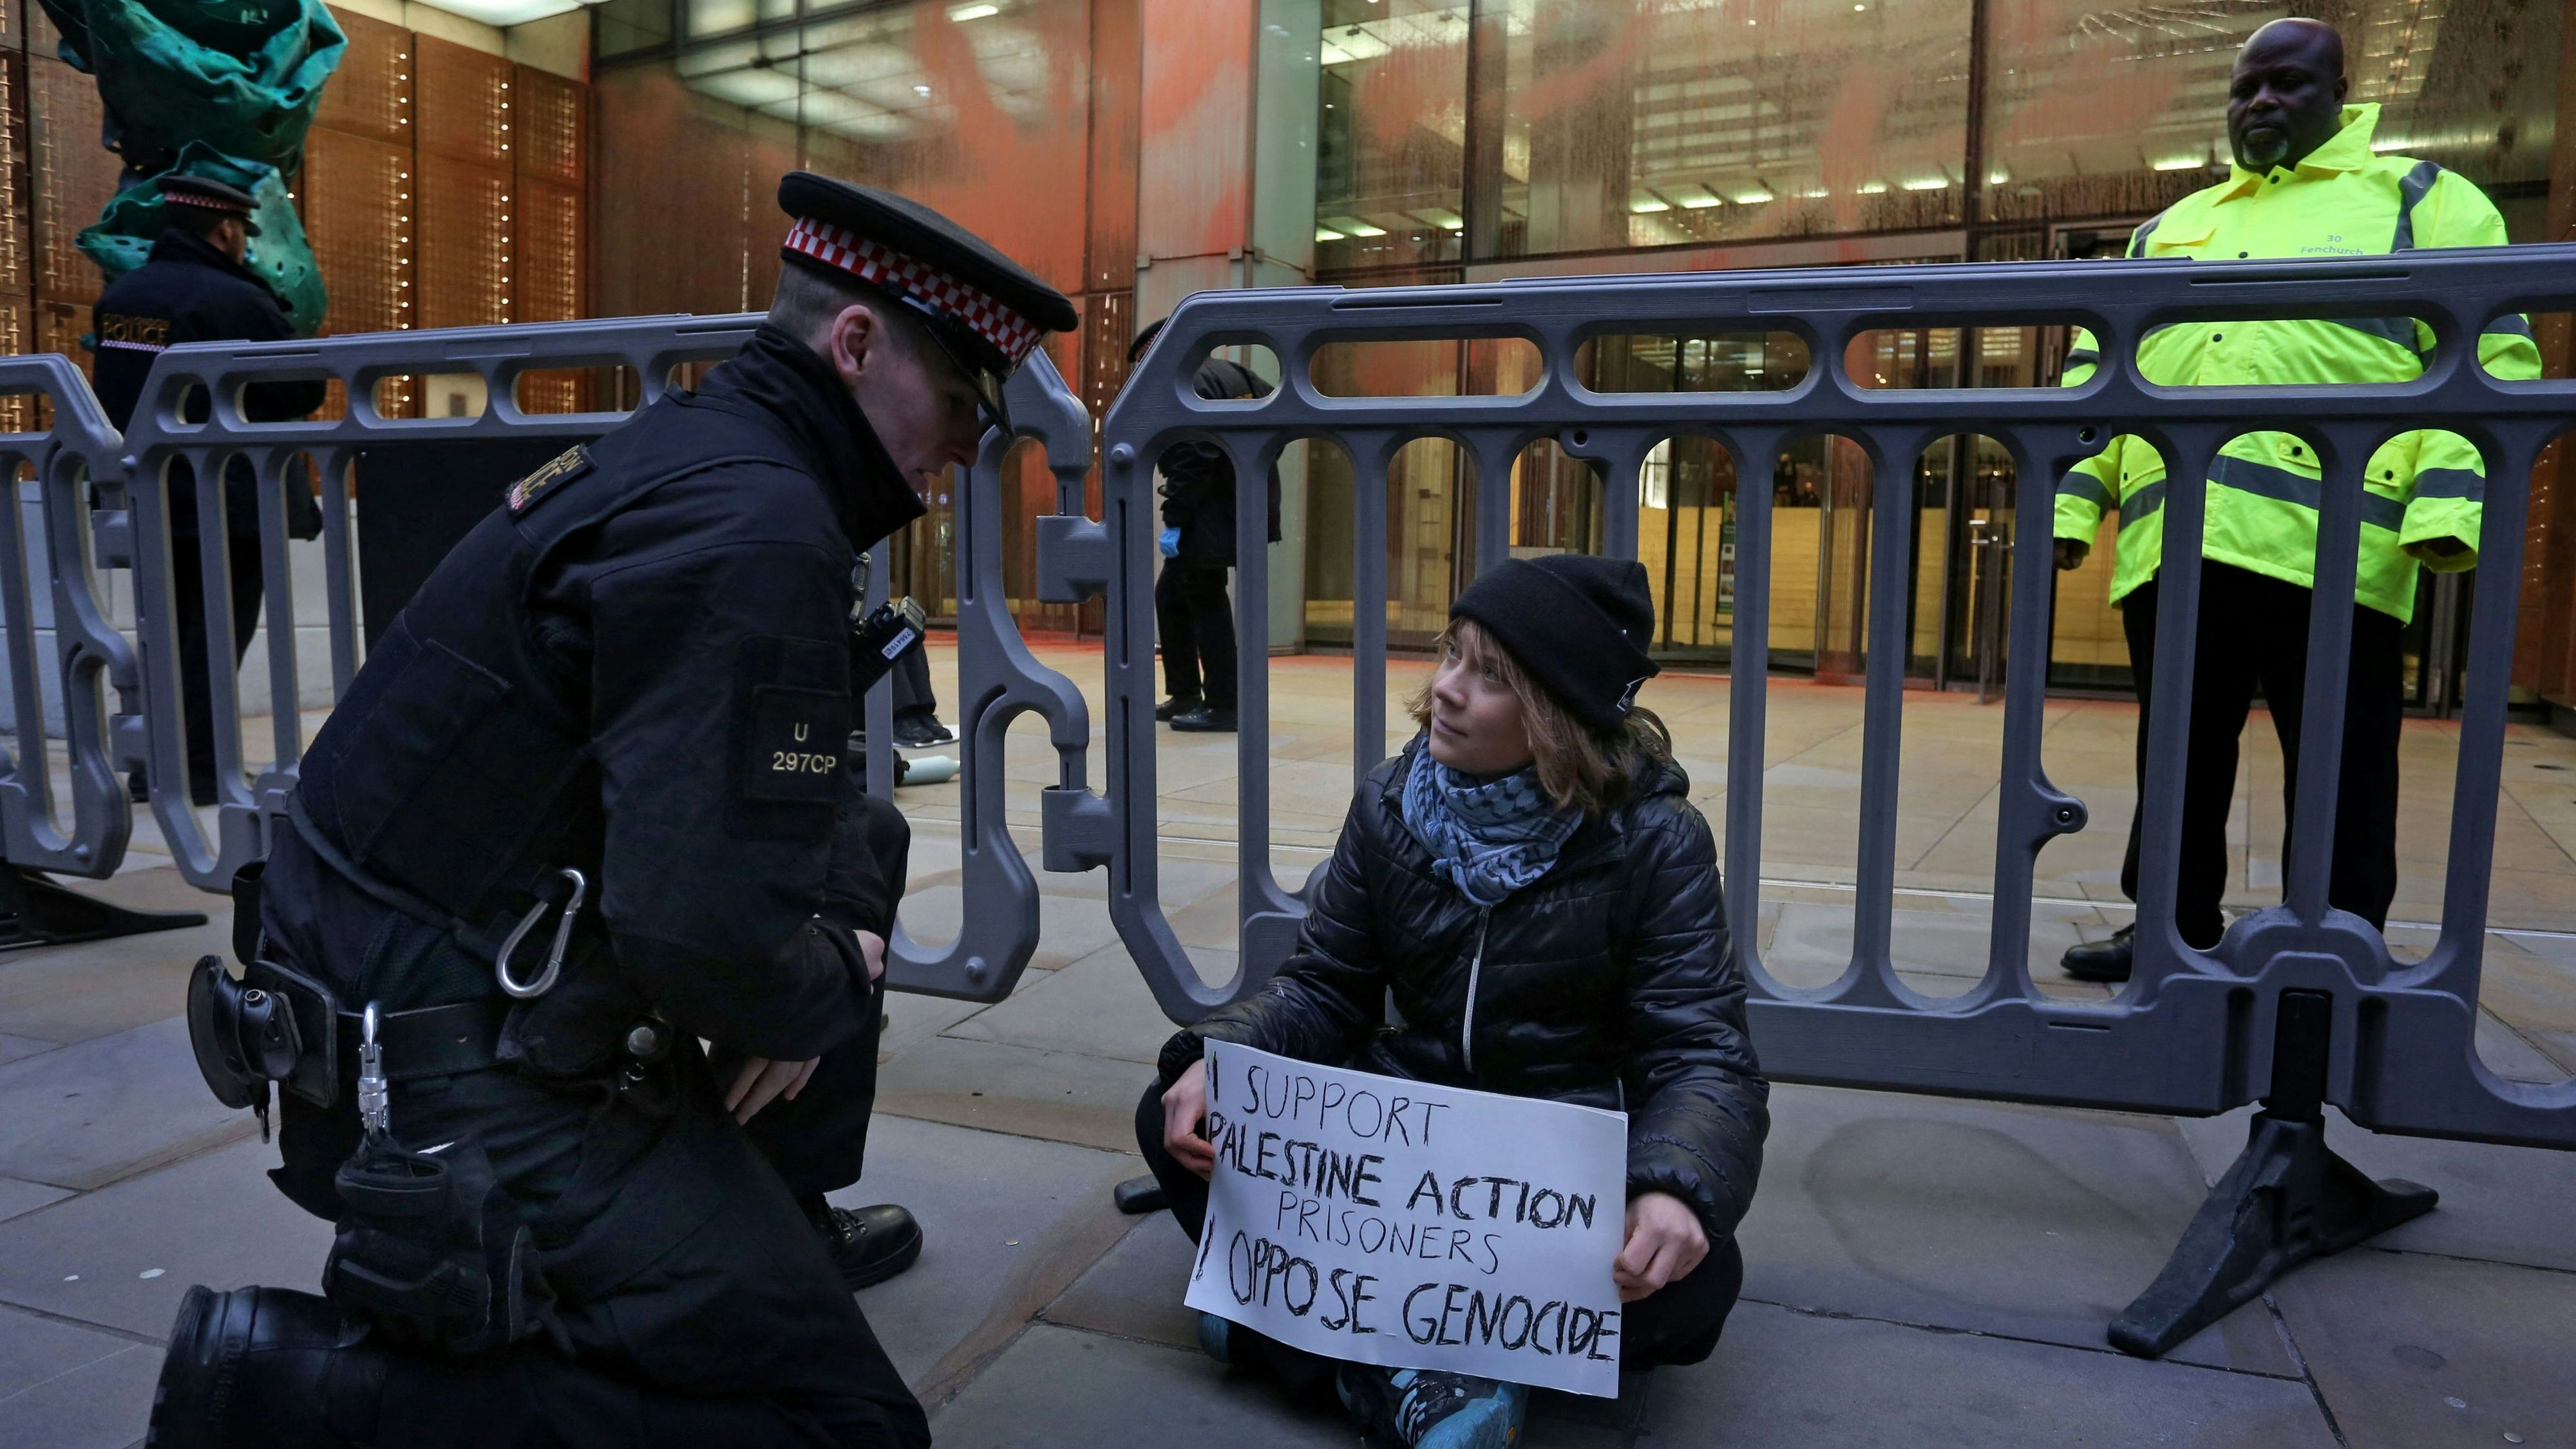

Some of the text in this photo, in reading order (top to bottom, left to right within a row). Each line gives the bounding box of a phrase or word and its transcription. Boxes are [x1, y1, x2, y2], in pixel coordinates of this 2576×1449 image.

[2300, 246, 2363, 255] Fenchurch
[102, 321, 169, 345] POLICE
[794, 722, 809, 742] U
[772, 750, 837, 775] 297CP
[1242, 1065, 1451, 1147] SUPPORT
[1208, 1111, 1597, 1230] PALESTINE ACTION
[1277, 1190, 1502, 1275] PRISONERS
[1193, 1212, 1622, 1361] I OPPOSE GENOCIDE
